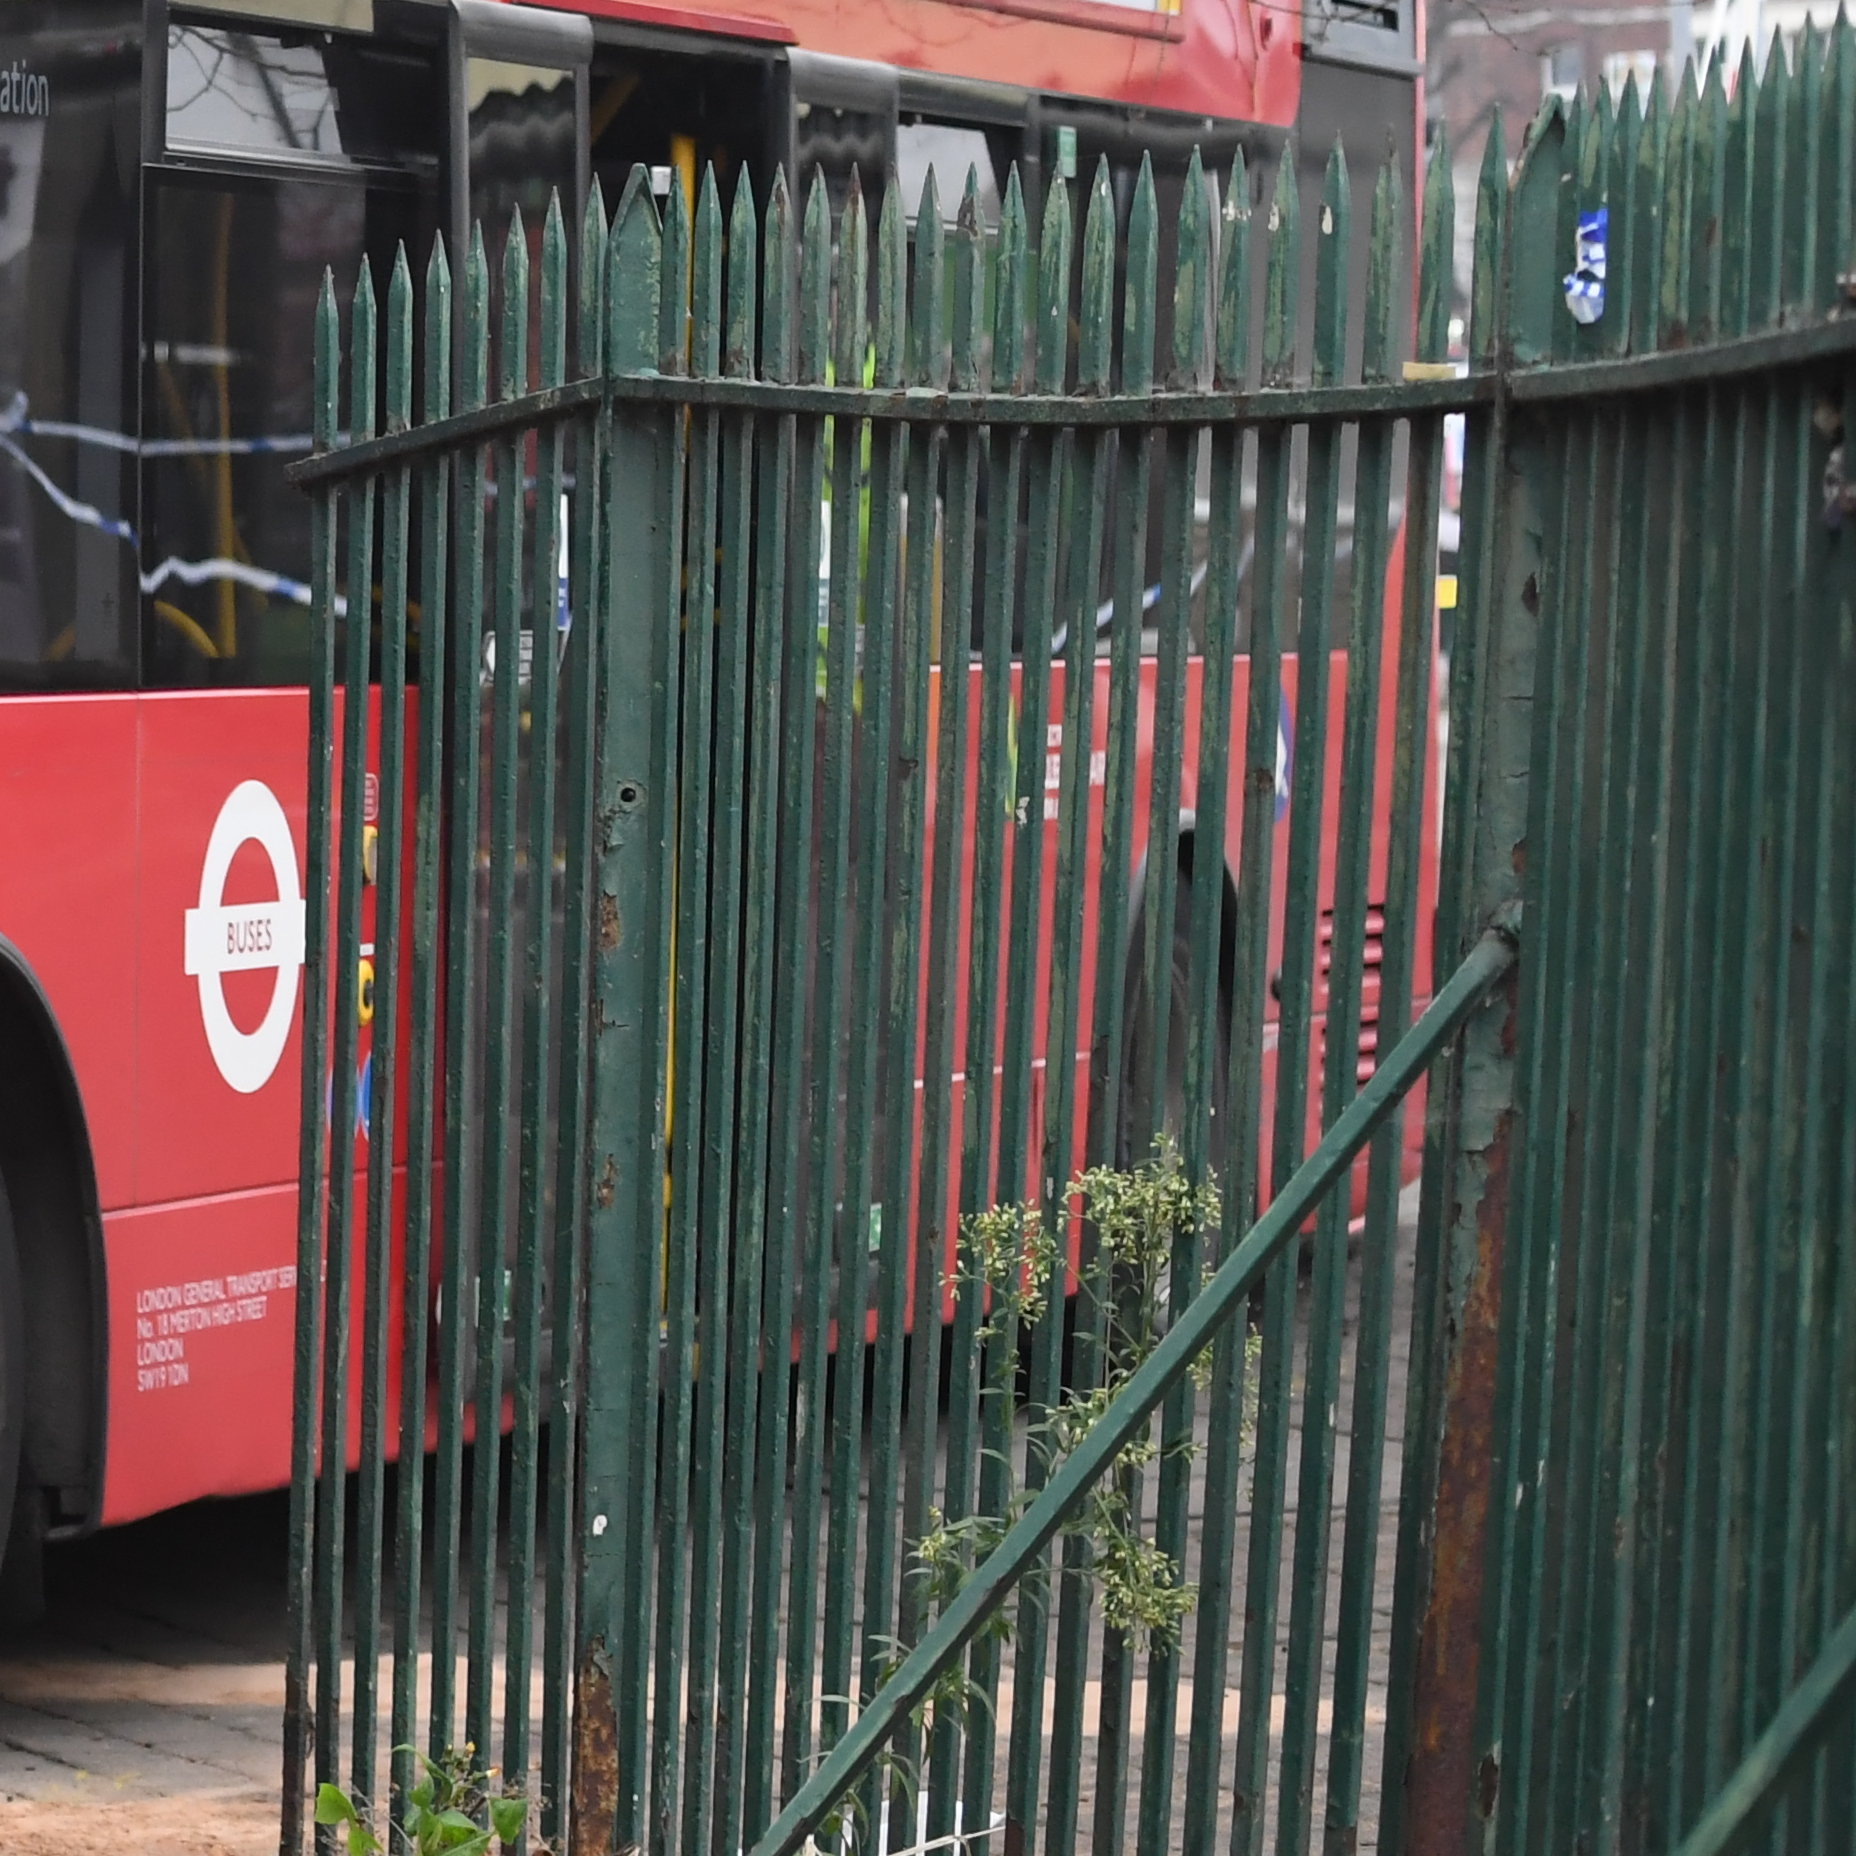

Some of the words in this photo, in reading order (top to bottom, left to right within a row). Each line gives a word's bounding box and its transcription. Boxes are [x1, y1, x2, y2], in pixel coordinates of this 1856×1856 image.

[226, 918, 273, 955] BUSES
[137, 1285, 182, 1313] LONDON
[137, 1337, 184, 1366] LONDON
